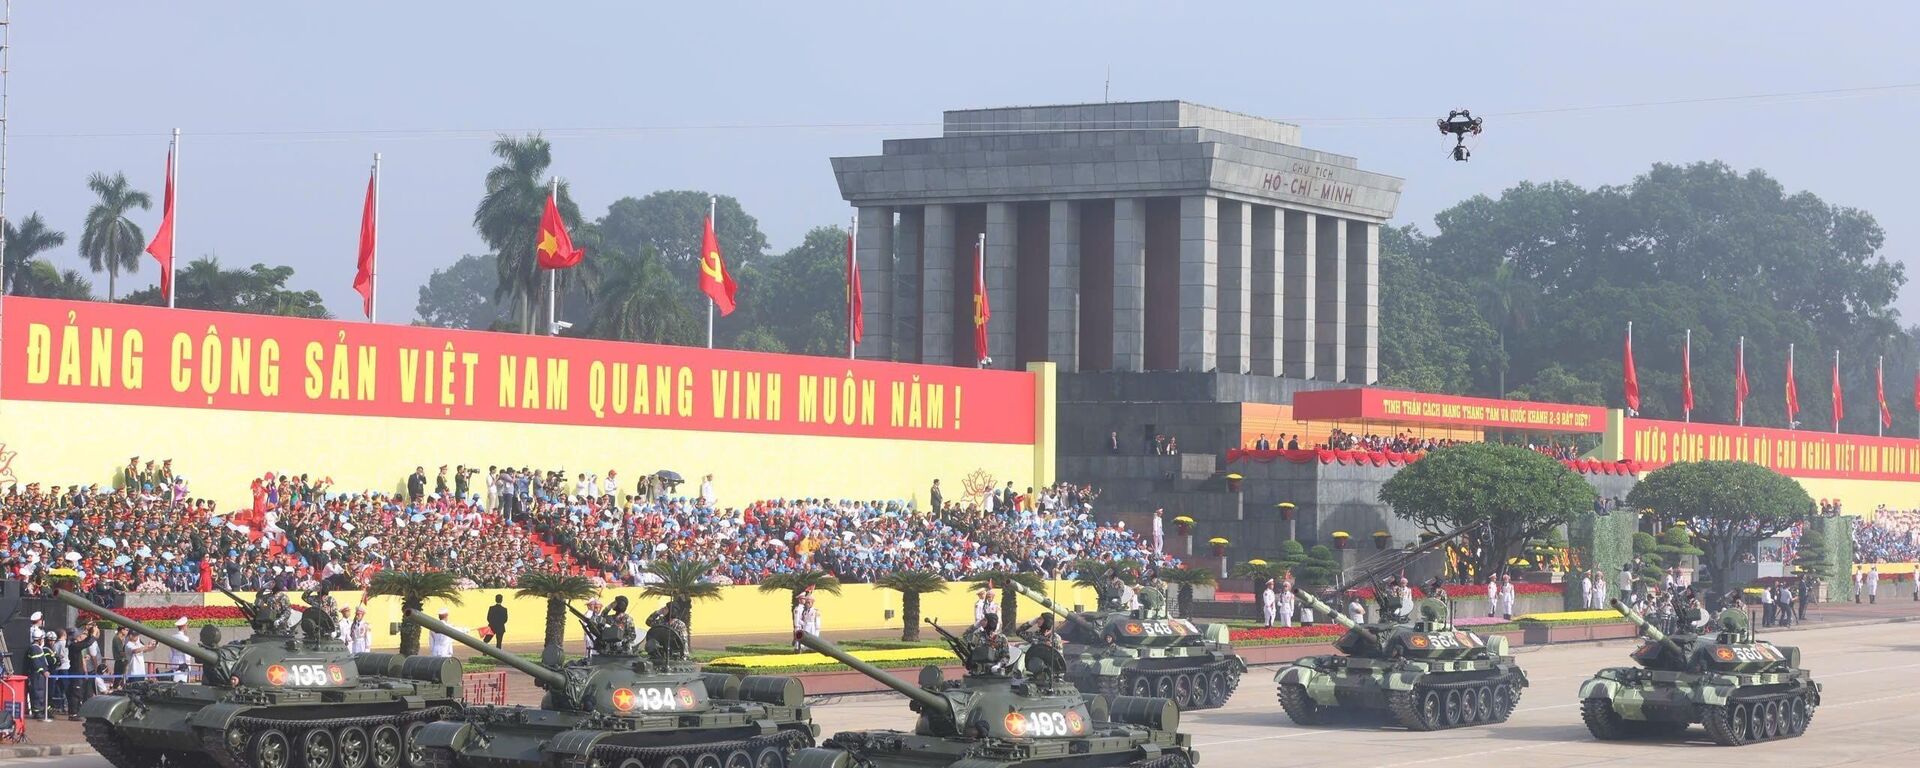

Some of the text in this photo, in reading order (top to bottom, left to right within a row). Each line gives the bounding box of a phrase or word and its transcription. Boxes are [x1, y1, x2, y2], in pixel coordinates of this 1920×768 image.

[27, 310, 144, 390] ĐẢNG
[170, 324, 280, 405] CỘNG
[304, 330, 377, 401] SẢN
[400, 341, 479, 416] VIỆT
[499, 355, 569, 412] NAM
[588, 360, 693, 419] QUANG
[711, 368, 782, 421] VINH
[798, 369, 876, 427] MUÔN
[891, 374, 944, 430] NĂM
[1635, 426, 1667, 464] NƯỚC
[1777, 433, 1797, 470] CHỦ
[1835, 439, 1856, 477] VIỆT
[1859, 445, 1878, 473] NAM
[1882, 442, 1906, 474] MUÔN
[1910, 443, 1920, 475] NĂ
[1427, 634, 1459, 648] 564
[1732, 647, 1764, 660] 560
[291, 664, 328, 686] 135
[638, 687, 677, 711] 134
[1030, 711, 1068, 737] 193
